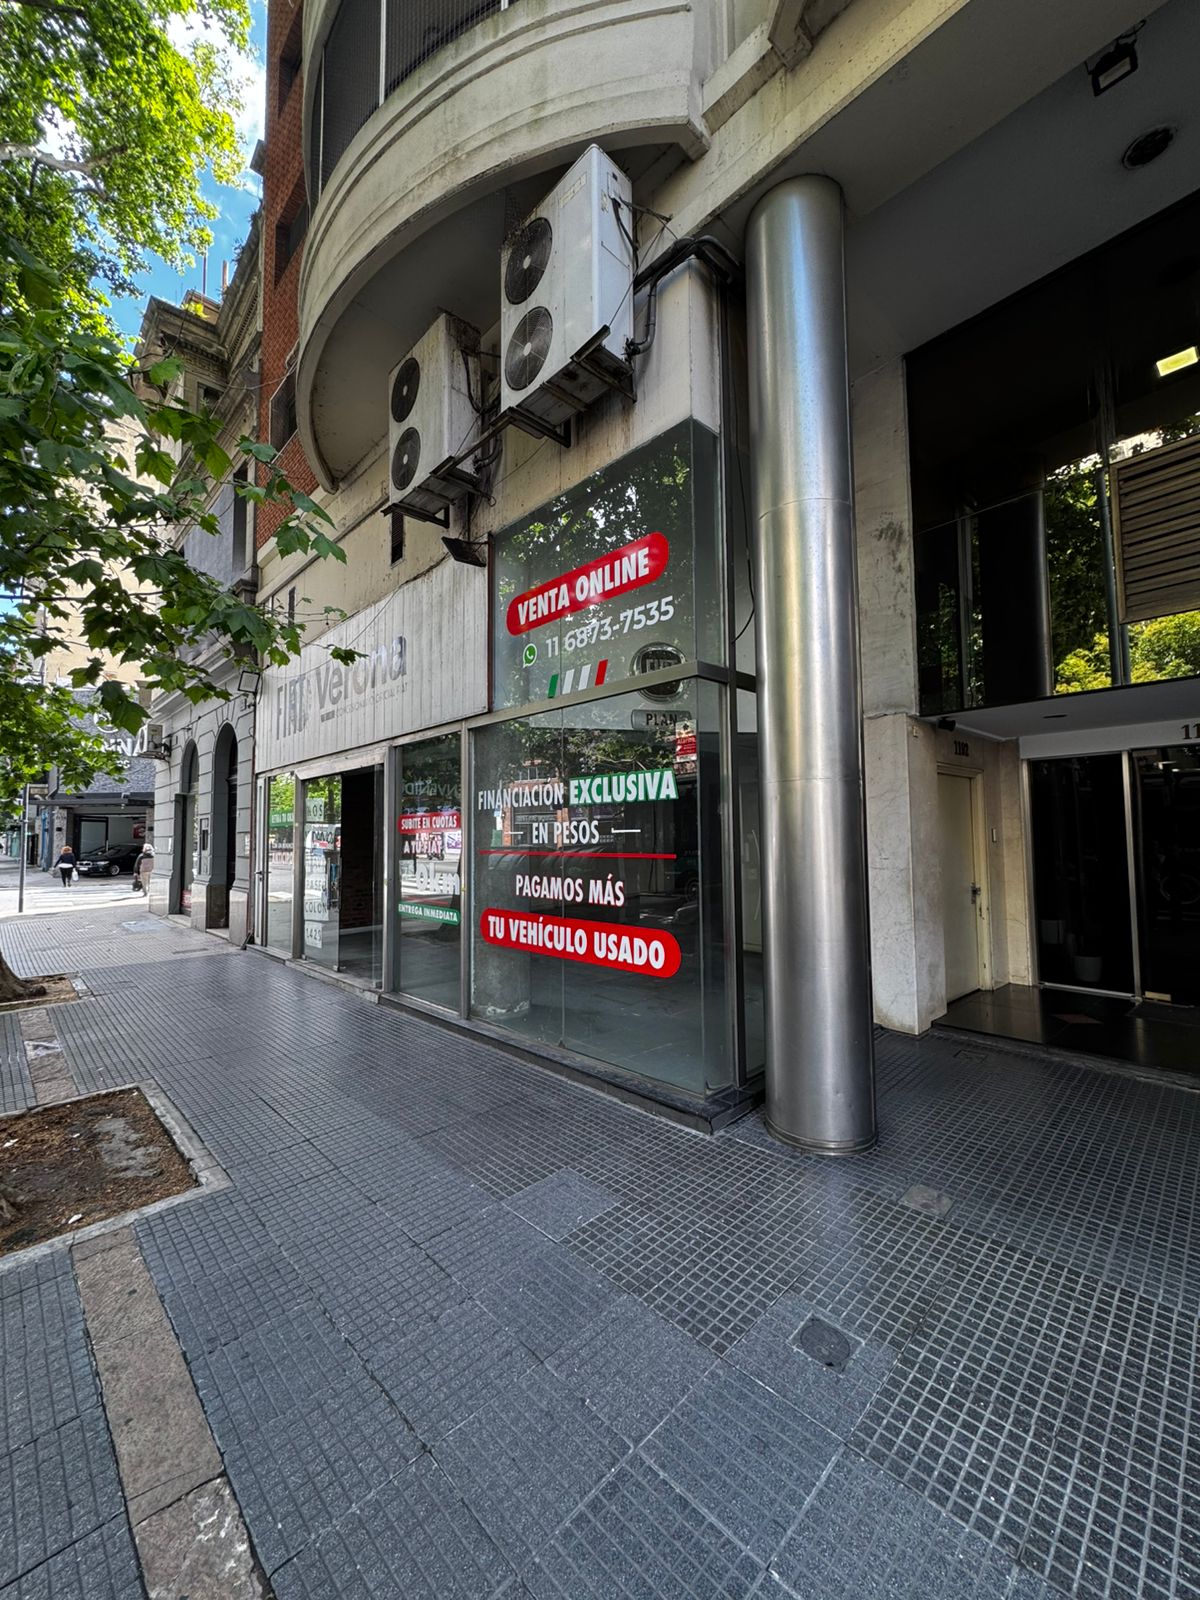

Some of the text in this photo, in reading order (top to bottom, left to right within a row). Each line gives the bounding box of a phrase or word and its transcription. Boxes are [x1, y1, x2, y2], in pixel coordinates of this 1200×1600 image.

[518, 547, 650, 625] VENTA ONLINE
[546, 596, 675, 658] 11 6873-7535
[316, 635, 407, 710] Verona
[646, 713, 678, 726] PLAN
[478, 770, 677, 810] FINANCIACIÓN EXCLUSIVA
[402, 814, 457, 830] SUBITE EN CUOTAS
[532, 820, 600, 844] EN PESOS
[404, 840, 410, 854] A
[516, 873, 625, 907] PAGAMOS MÁS
[399, 903, 458, 922] ENTREGA INMEDIATA
[488, 915, 666, 970] TU VEHÍCULO USADO
